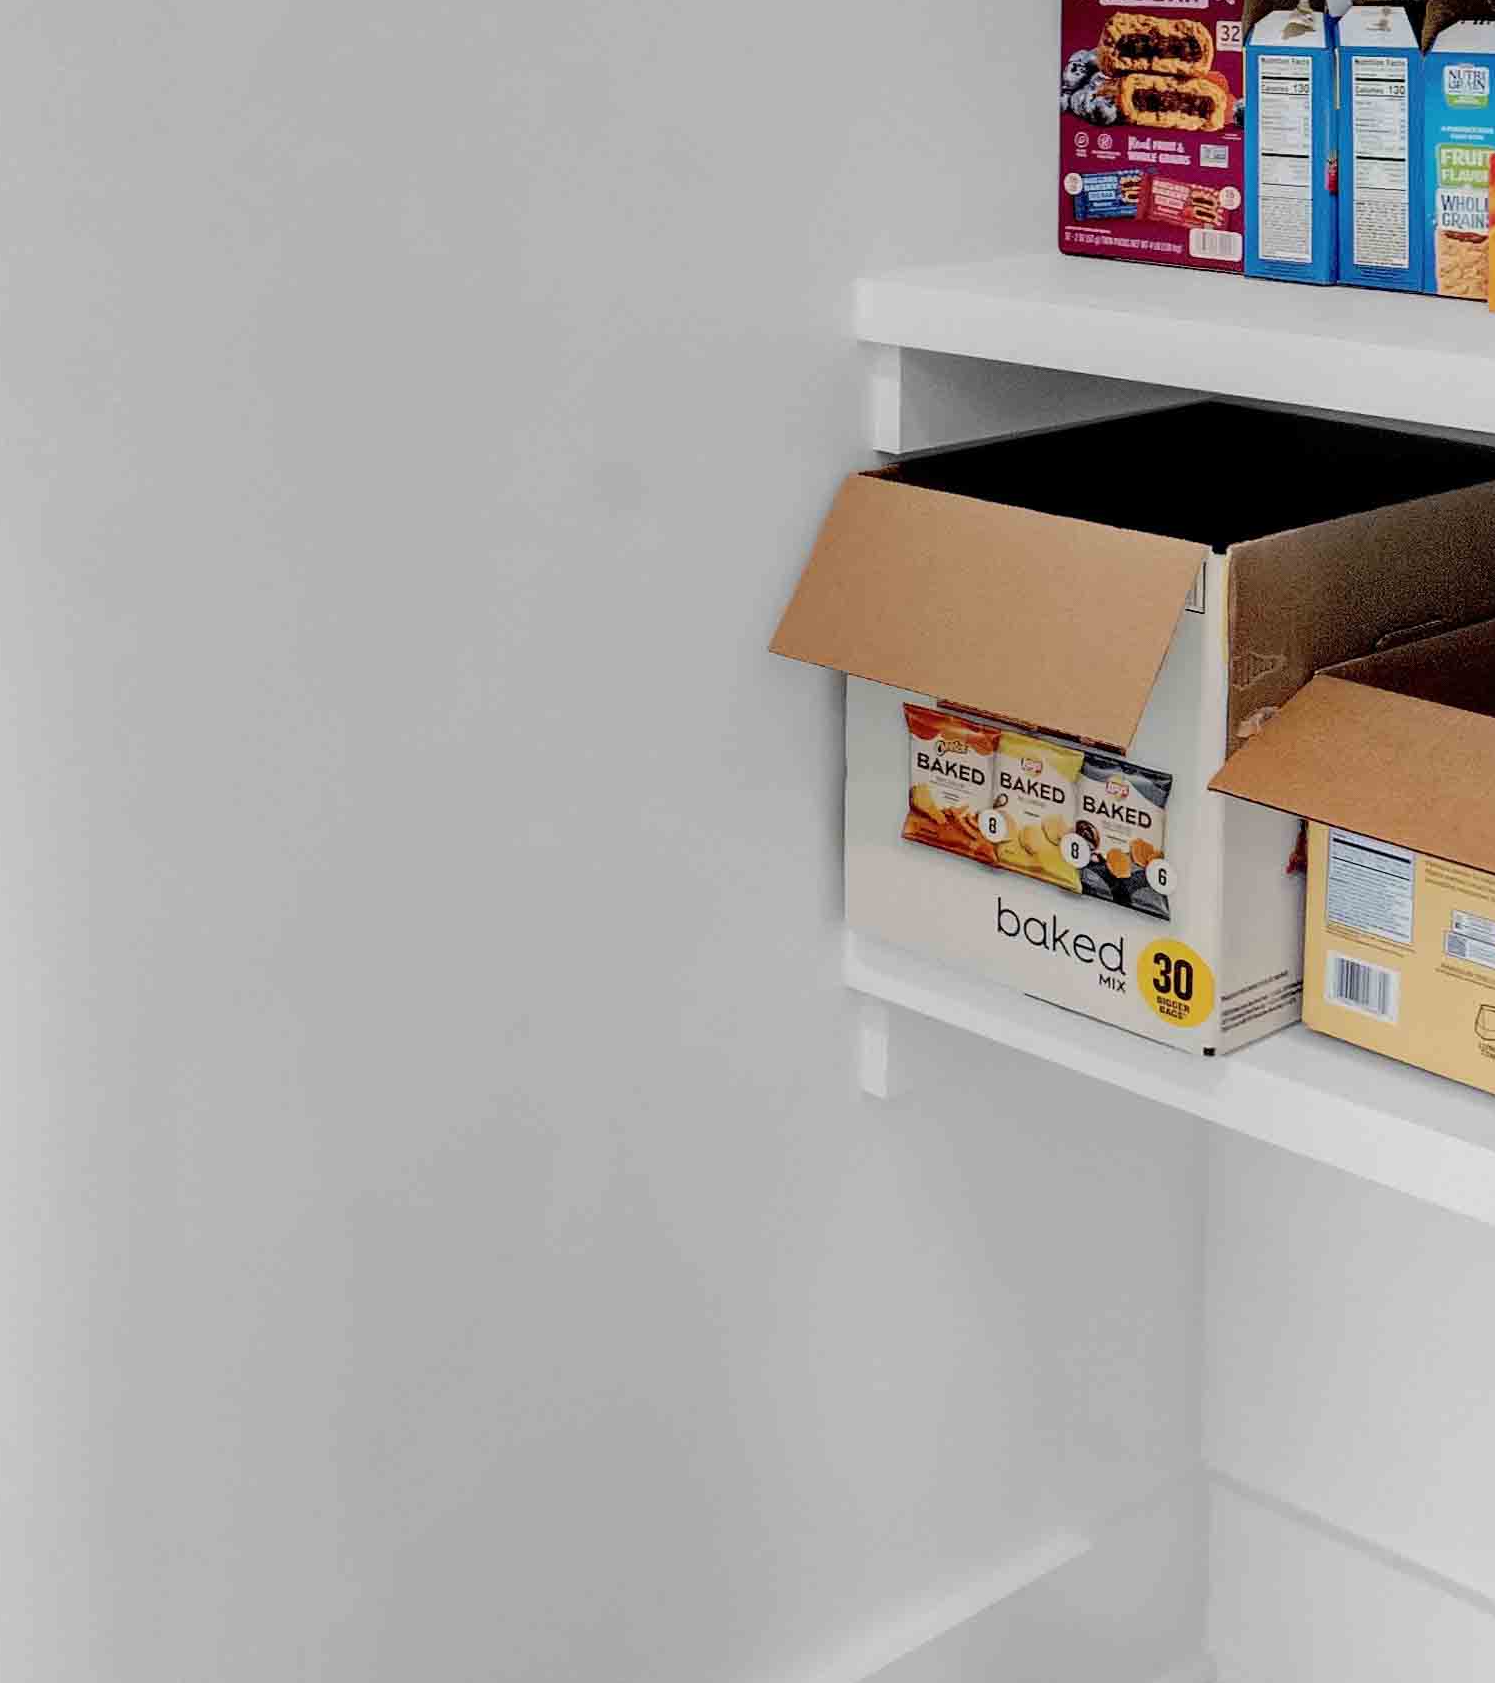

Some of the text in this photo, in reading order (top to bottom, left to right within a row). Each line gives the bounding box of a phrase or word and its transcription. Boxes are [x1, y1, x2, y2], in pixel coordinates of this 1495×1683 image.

[1220, 23, 1241, 44] 32
[1293, 84, 1310, 94] 130
[1389, 85, 1406, 96] 130
[916, 752, 986, 786] BAKED
[999, 771, 1066, 805] BAKED
[1082, 795, 1153, 830] BAKED
[988, 817, 997, 834] 8
[1071, 841, 1080, 860] 8
[1158, 868, 1167, 886] 6
[996, 896, 1127, 975] baked
[1098, 973, 1127, 994] MIX
[1152, 951, 1194, 1002] 30
